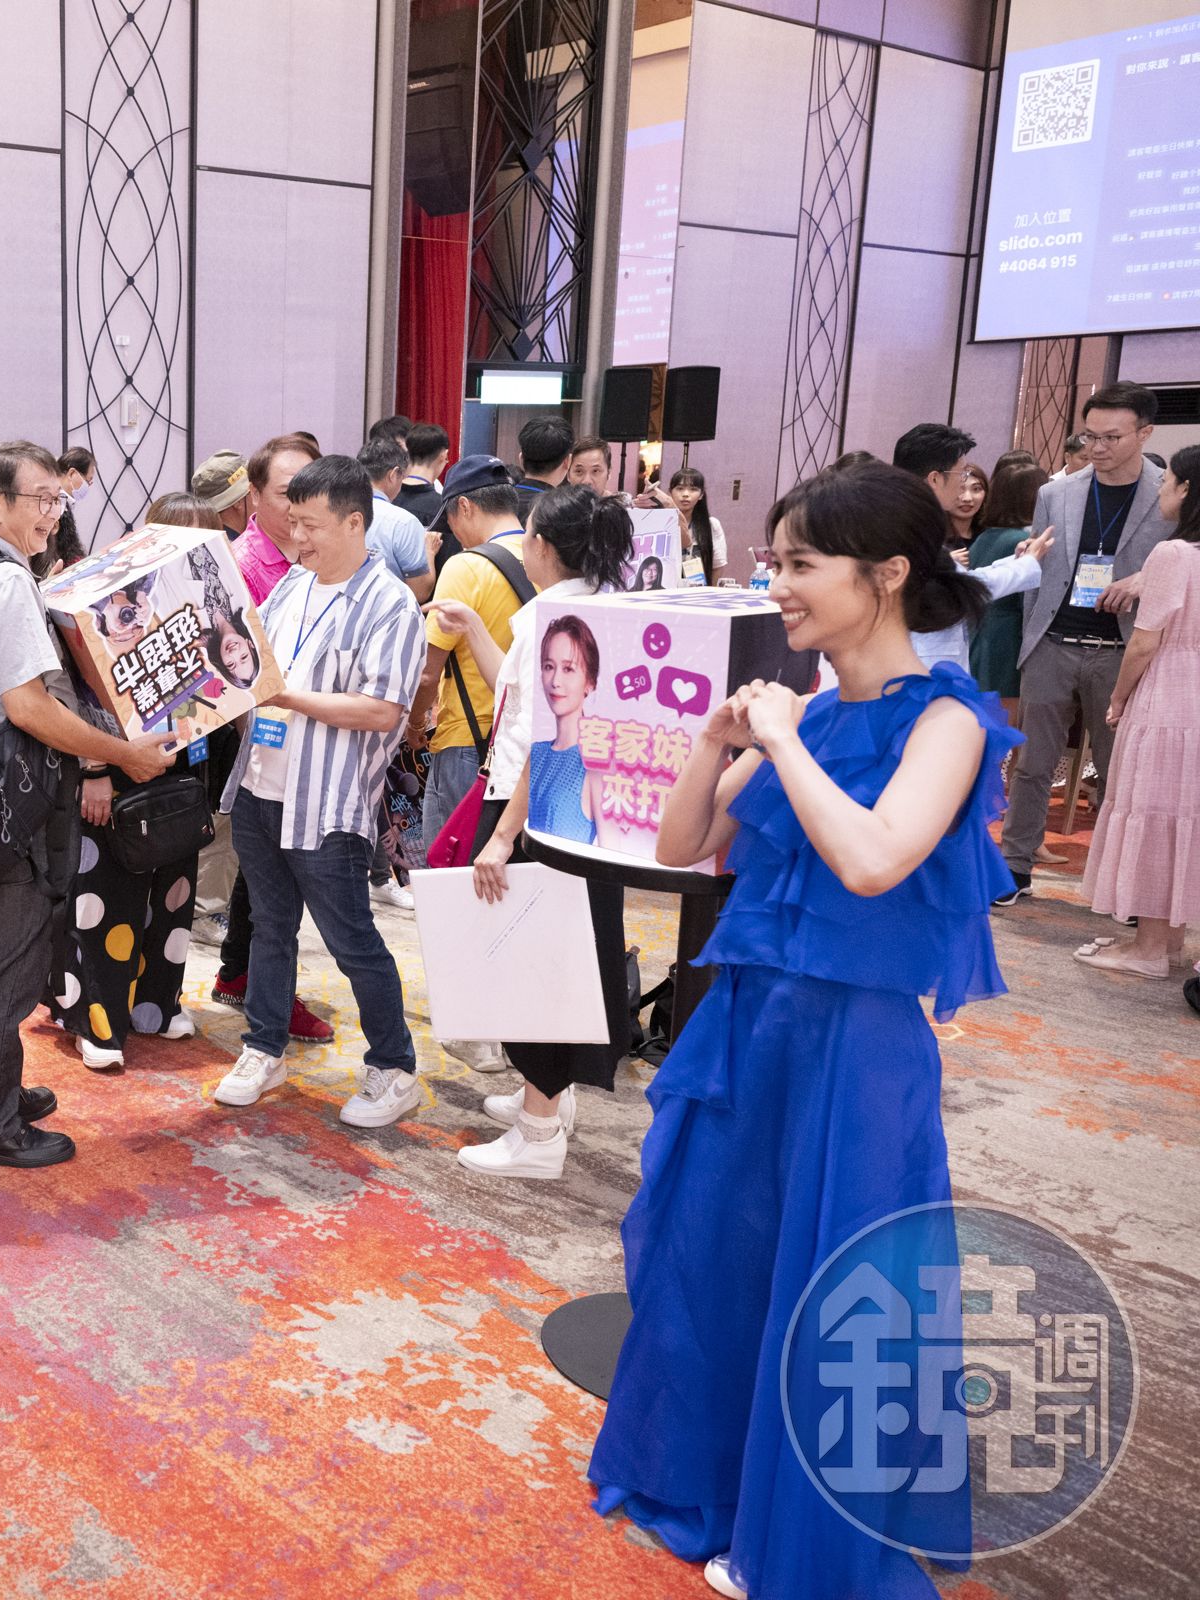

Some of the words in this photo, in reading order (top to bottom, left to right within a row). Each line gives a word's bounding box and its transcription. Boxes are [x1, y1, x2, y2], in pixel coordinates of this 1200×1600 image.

[1014, 208, 1072, 228] 加入位置
[999, 231, 1083, 252] slido.com
[999, 257, 1047, 273] #4064
[1050, 254, 1077, 269] 915
[112, 605, 201, 694] 逛超市
[131, 648, 201, 713] 不專業
[633, 676, 647, 689] 50
[579, 717, 691, 774] 客家妹
[601, 773, 673, 823] 來打
